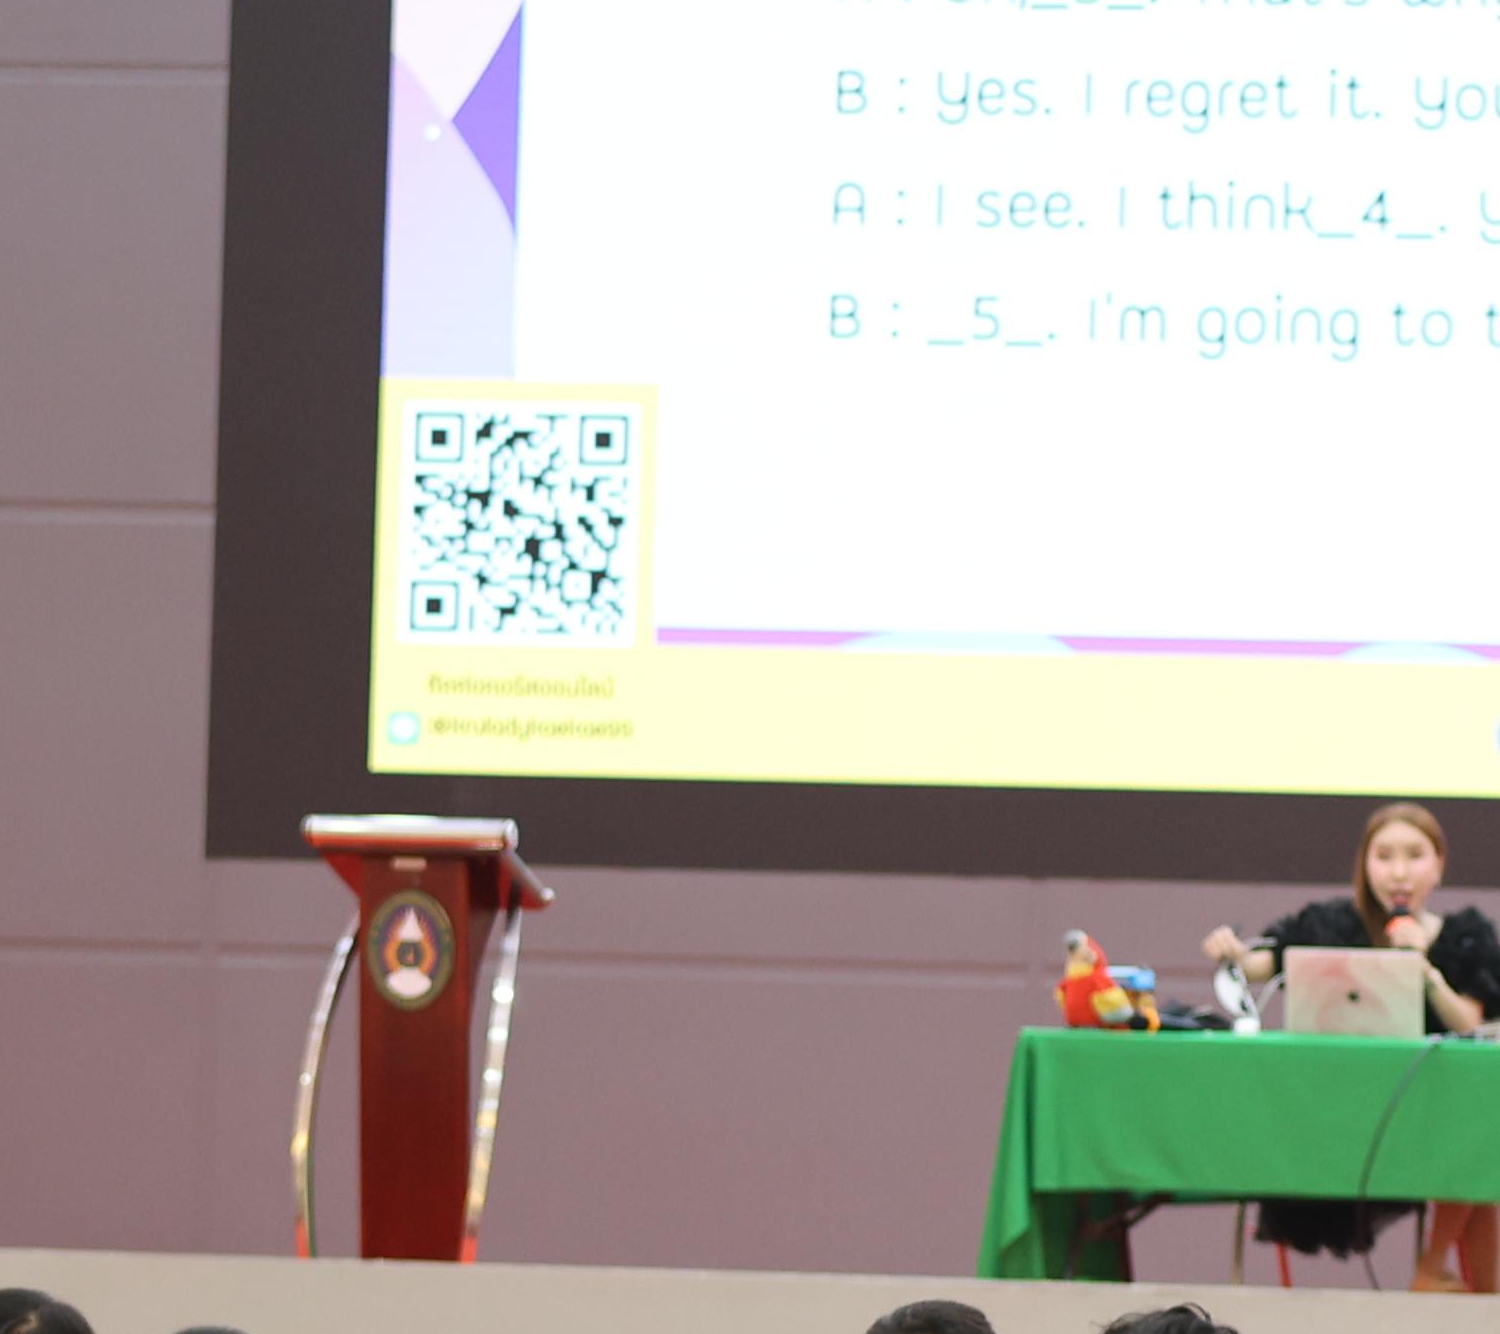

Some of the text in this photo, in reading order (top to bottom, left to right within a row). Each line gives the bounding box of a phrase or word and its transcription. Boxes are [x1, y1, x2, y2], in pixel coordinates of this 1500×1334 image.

[834, 67, 870, 117] B
[935, 70, 1054, 127] Yes.
[1123, 73, 1299, 136] regret
[1328, 67, 1383, 121] it.
[831, 180, 868, 226] A
[975, 189, 1087, 231] see.
[828, 292, 863, 341] B
[1088, 291, 1167, 343] I'm
[1195, 292, 1361, 364] going
[1390, 301, 1455, 349] to
